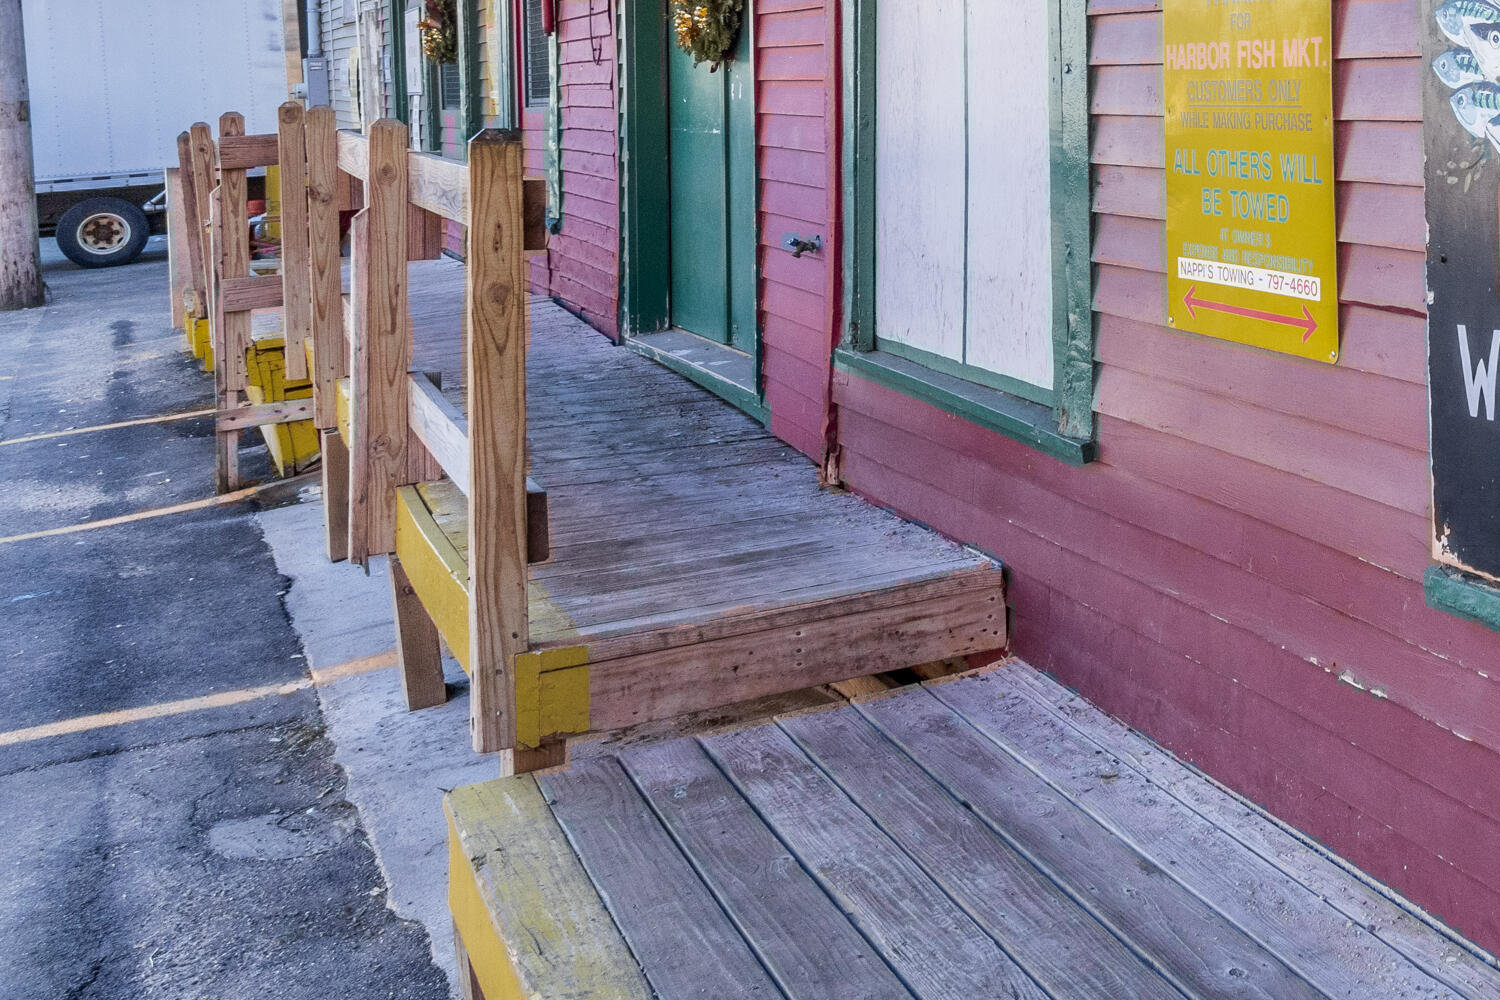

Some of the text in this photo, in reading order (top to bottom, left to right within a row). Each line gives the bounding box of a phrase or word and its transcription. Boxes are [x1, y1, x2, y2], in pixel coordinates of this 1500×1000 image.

[1230, 12, 1251, 30] FOR
[1166, 36, 1327, 70] HARBOR FISH MKT.
[1187, 79, 1302, 102] CUSTOMERS ONLY
[1180, 111, 1312, 132] WHILE MAKING PURCHASE
[1174, 148, 1323, 184] ALL OTHERS WILL
[1201, 188, 1290, 223] BE TOWED
[1180, 261, 1214, 279] NAPPI'S
[1217, 265, 1254, 286] TOWING
[1267, 273, 1318, 297] 797-4660
